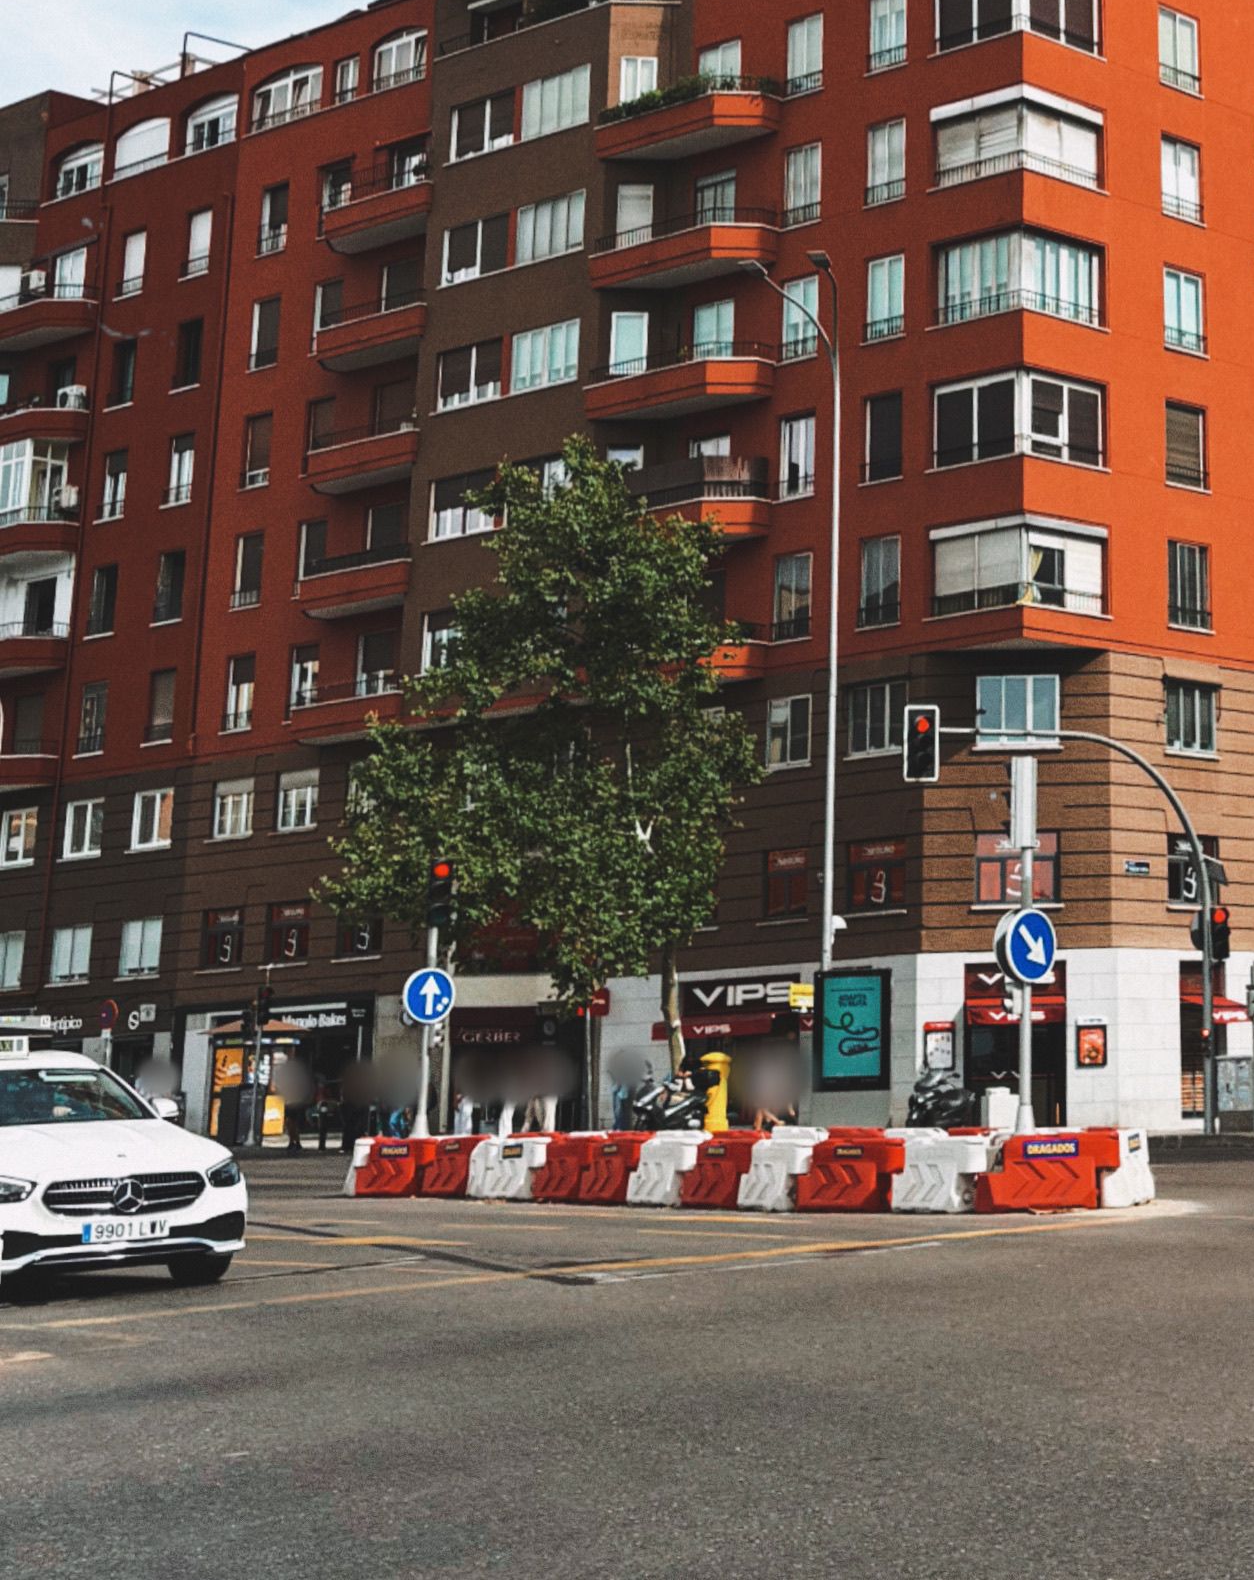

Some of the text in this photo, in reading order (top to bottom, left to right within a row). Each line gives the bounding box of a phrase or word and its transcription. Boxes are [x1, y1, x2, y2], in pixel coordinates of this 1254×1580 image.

[692, 982, 792, 1008] VIPS
[318, 1012, 347, 1028] Bakes
[1212, 1011, 1248, 1021] VIPS
[693, 1024, 731, 1034] VIPS
[462, 1031, 521, 1043] GERBER
[1027, 1143, 1076, 1155] DRAGADOS
[95, 1222, 134, 1239] 9901
